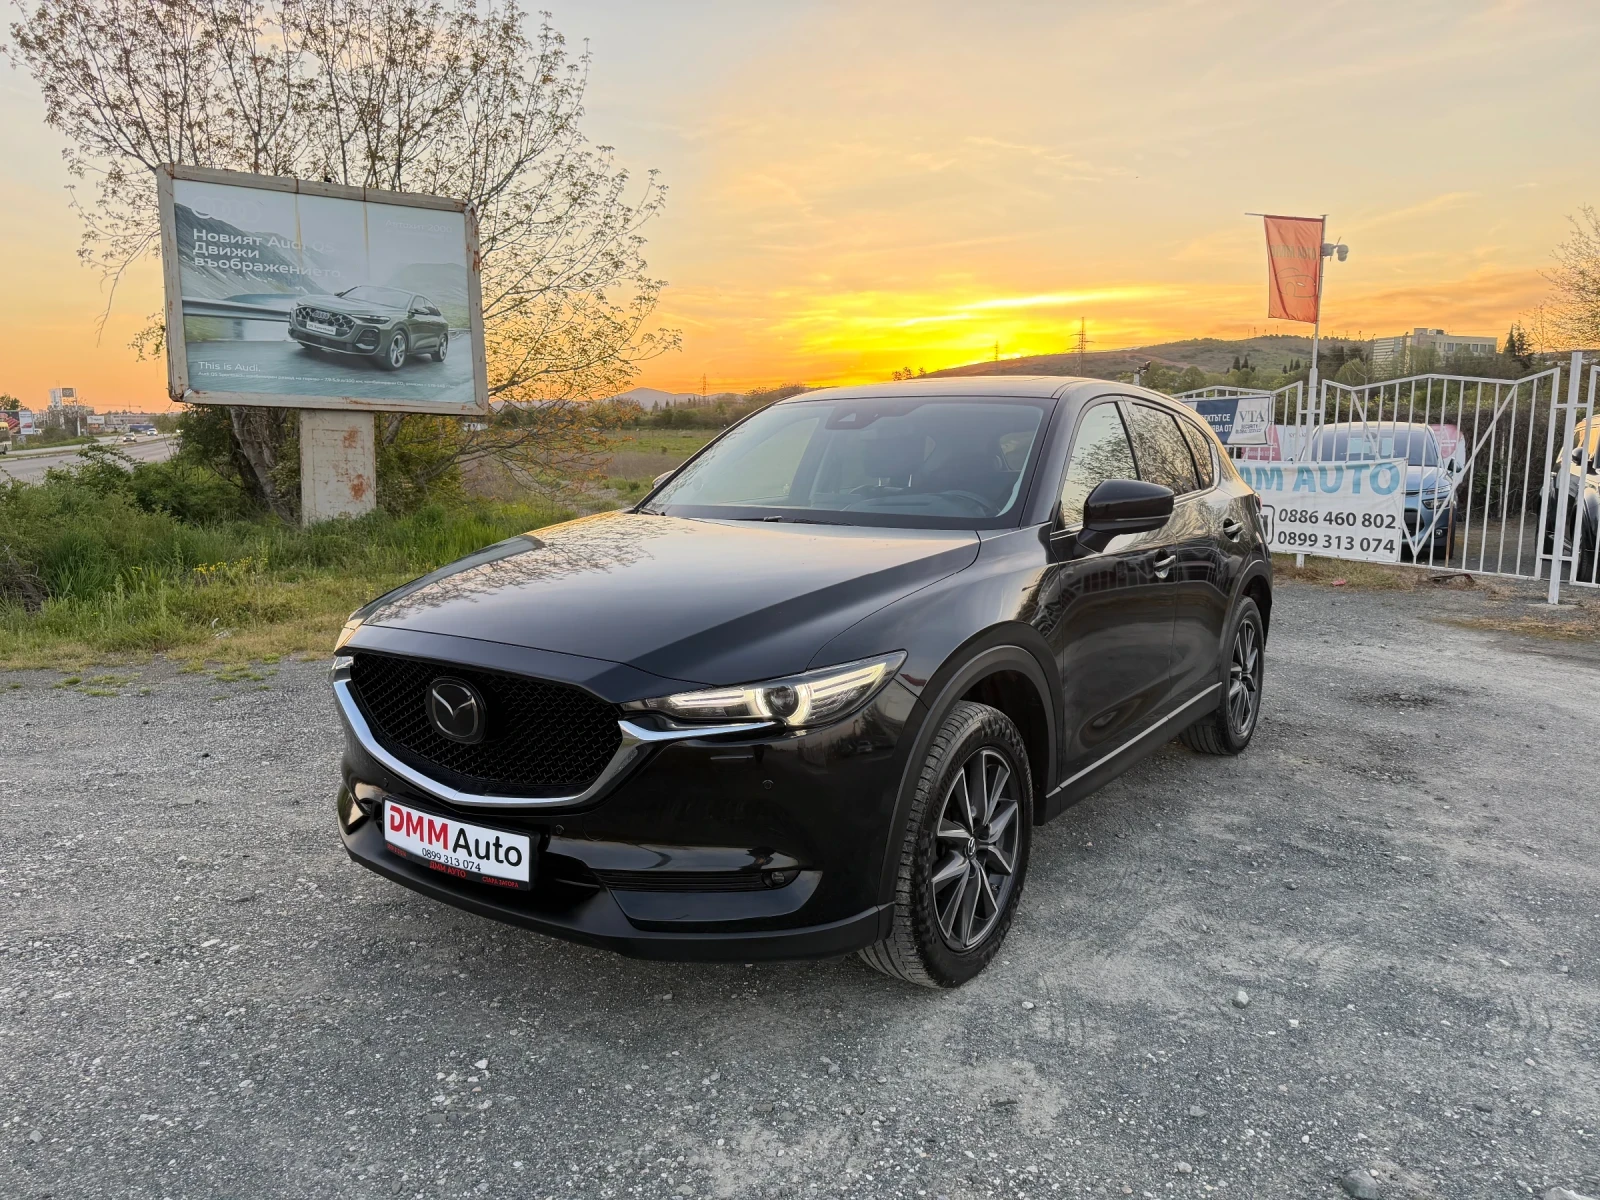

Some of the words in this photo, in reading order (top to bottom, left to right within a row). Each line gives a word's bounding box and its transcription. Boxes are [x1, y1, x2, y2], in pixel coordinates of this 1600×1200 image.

[193, 228, 263, 246] Новият
[193, 242, 260, 259] Движи
[198, 361, 220, 370] This
[223, 362, 232, 371] is
[234, 363, 261, 372] Audi.
[1222, 413, 1231, 422] СЕ
[1238, 410, 1265, 423] VTA
[1224, 424, 1233, 432] ОТ
[1292, 462, 1400, 496] AUTO
[1279, 508, 1319, 524] 0886
[1323, 511, 1357, 527] 460
[1361, 513, 1396, 529] 802
[1277, 531, 1318, 547] 0899
[1322, 534, 1355, 551] 313
[1360, 537, 1396, 554] 074
[389, 804, 449, 851] DMM
[452, 827, 523, 867] Auto
[421, 847, 442, 861] 0899
[443, 855, 461, 867] 313
[462, 859, 482, 872] 074
[447, 867, 467, 879] АУТО
